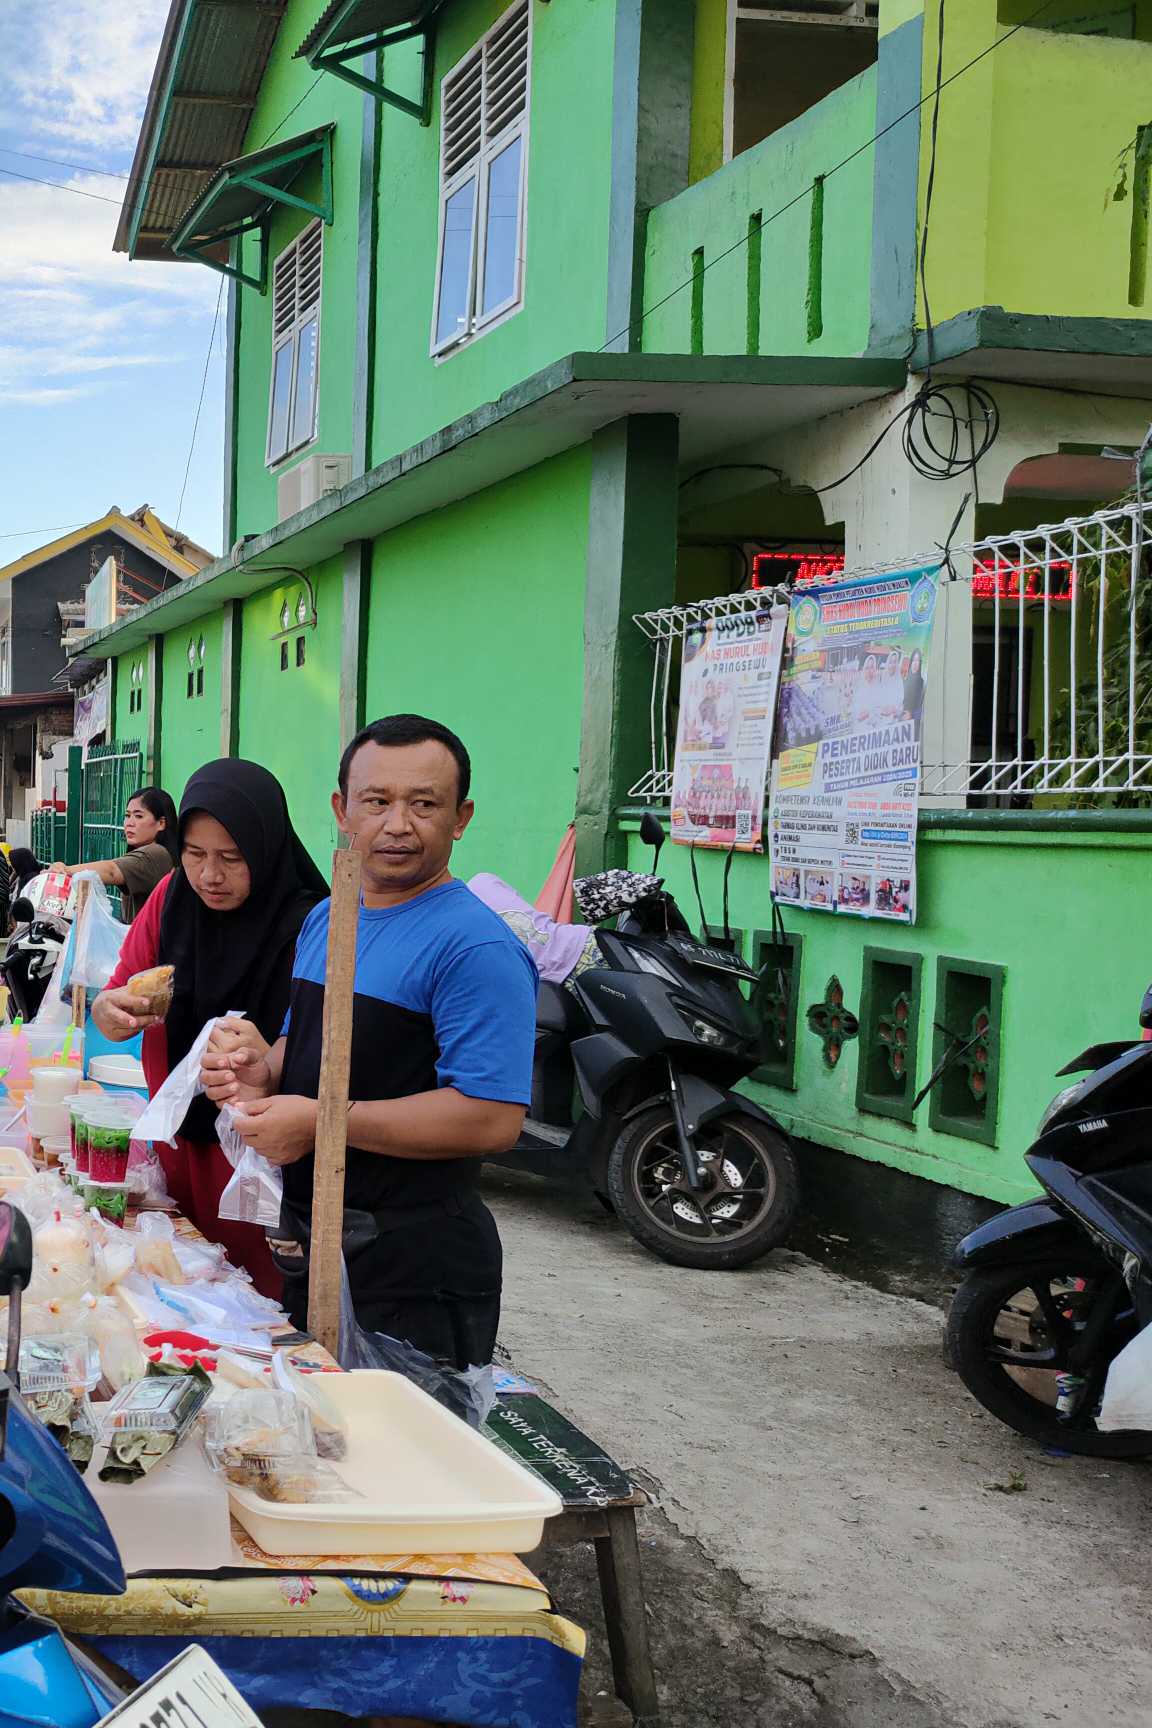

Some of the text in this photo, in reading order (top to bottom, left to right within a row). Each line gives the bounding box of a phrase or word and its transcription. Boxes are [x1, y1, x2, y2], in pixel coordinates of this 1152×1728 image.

[715, 616, 756, 640] PPDB
[822, 724, 911, 759] PENERIMAAN
[823, 758, 862, 779] PESERTA
[864, 751, 889, 773] DIDIK
[892, 744, 919, 768] BARU
[780, 834, 801, 842] ANIMASI
[1078, 1119, 1108, 1133] YAMAHA
[499, 1409, 536, 1436] SAYA
